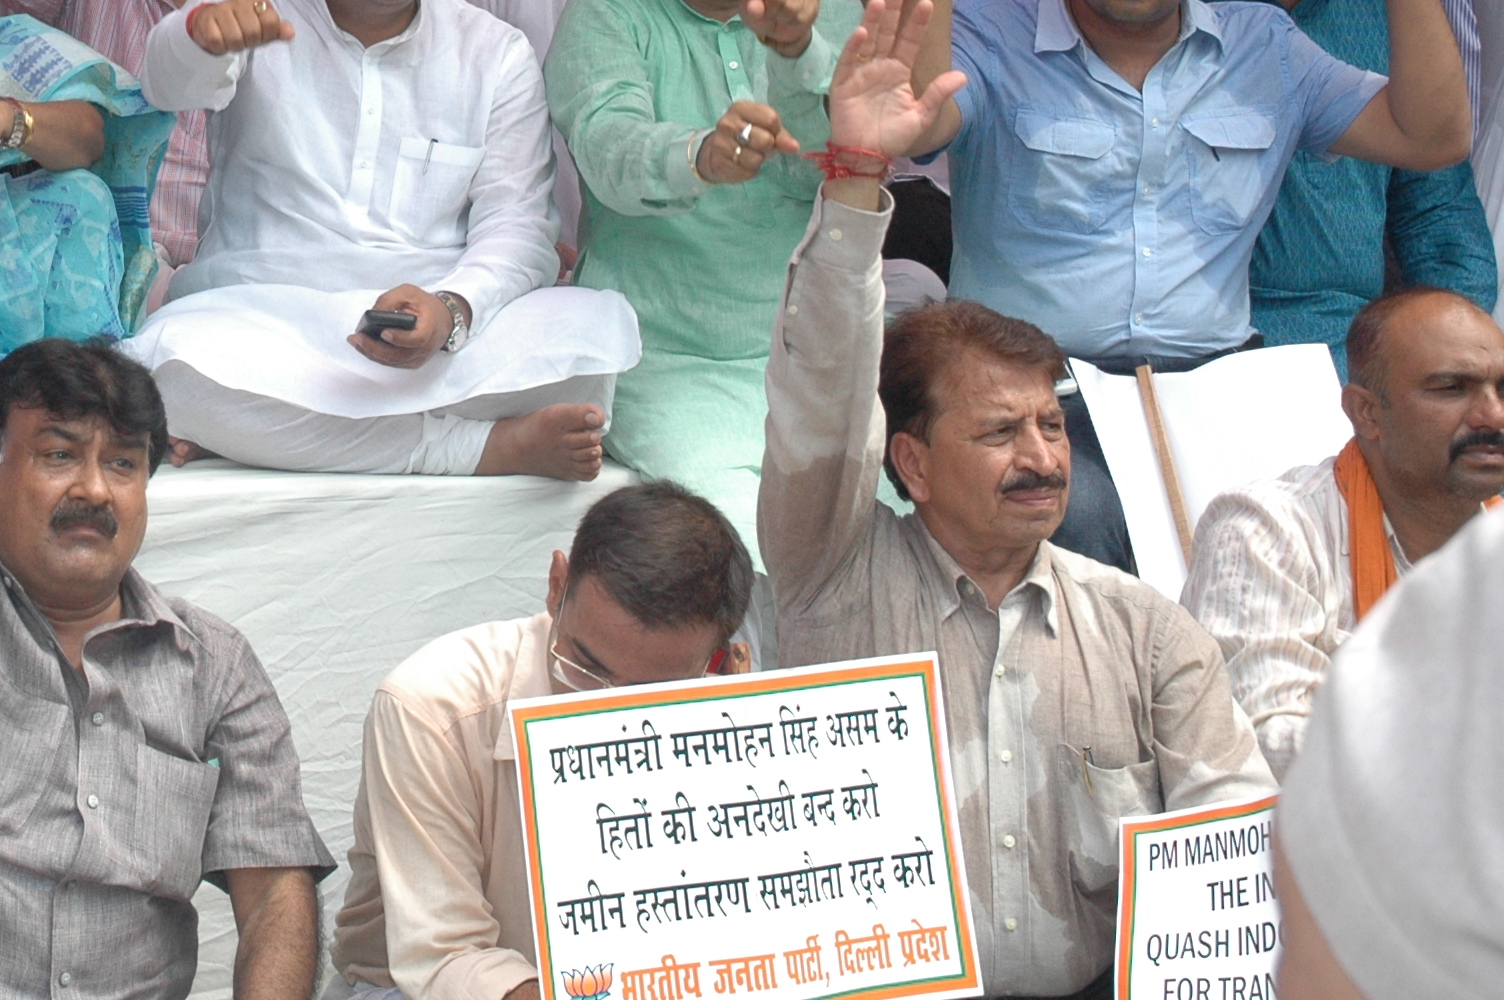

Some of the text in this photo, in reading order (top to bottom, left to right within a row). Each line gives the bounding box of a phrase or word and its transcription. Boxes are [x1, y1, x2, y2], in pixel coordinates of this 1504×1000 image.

[549, 691, 909, 784] प्रधानमंत्री मनमोहन सिंह असम के
[596, 769, 880, 860] हितों की अनदेखी बन्द करो
[1149, 840, 1178, 871] PM
[557, 879, 626, 935] जमीन
[633, 869, 751, 933] हस्तांतरण
[757, 851, 844, 910] समझौता
[891, 836, 935, 888] करो
[1207, 876, 1249, 911] THE
[621, 918, 950, 1000] भारतीय जनता पार्टी, दिल्ली प्रदेश
[1147, 929, 1229, 966] QUASH
[1164, 978, 1210, 1000] FOR
